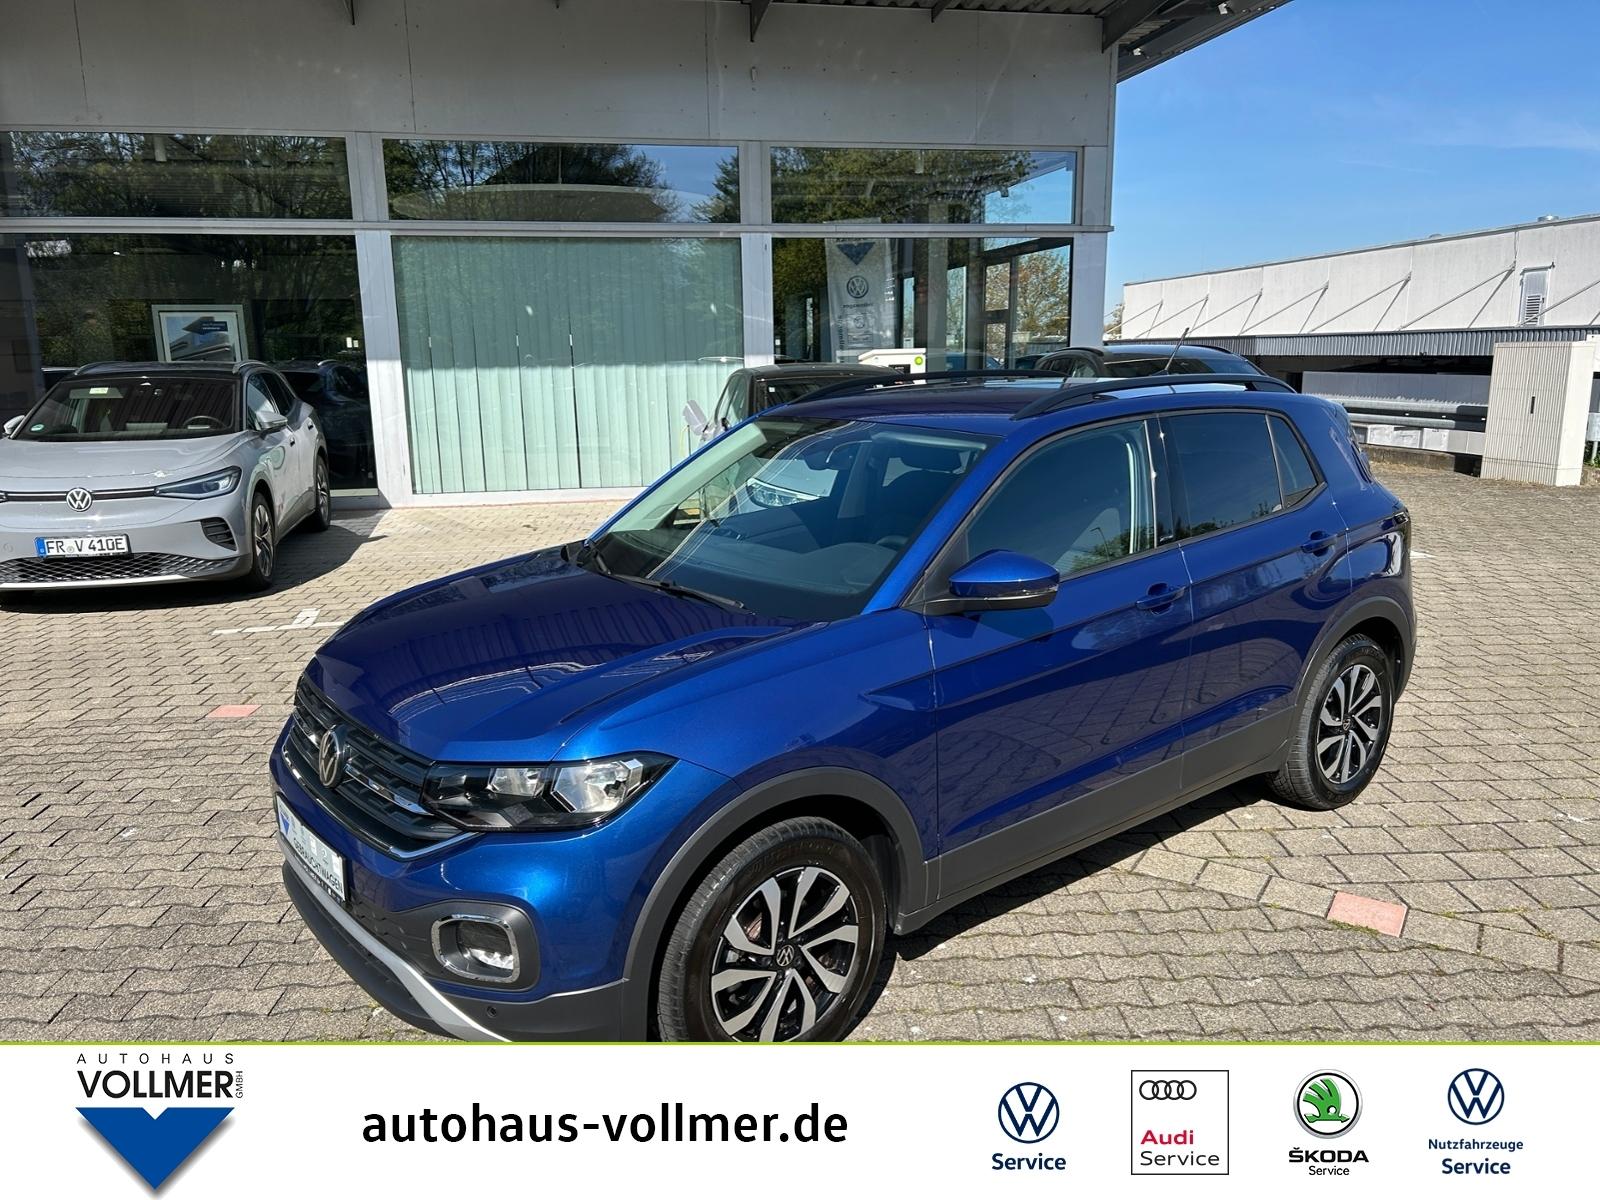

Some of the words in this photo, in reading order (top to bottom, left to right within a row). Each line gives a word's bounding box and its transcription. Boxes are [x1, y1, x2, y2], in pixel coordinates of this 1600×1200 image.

[46, 540, 65, 553] FR
[75, 540, 84, 552] V
[88, 538, 125, 551] 410E
